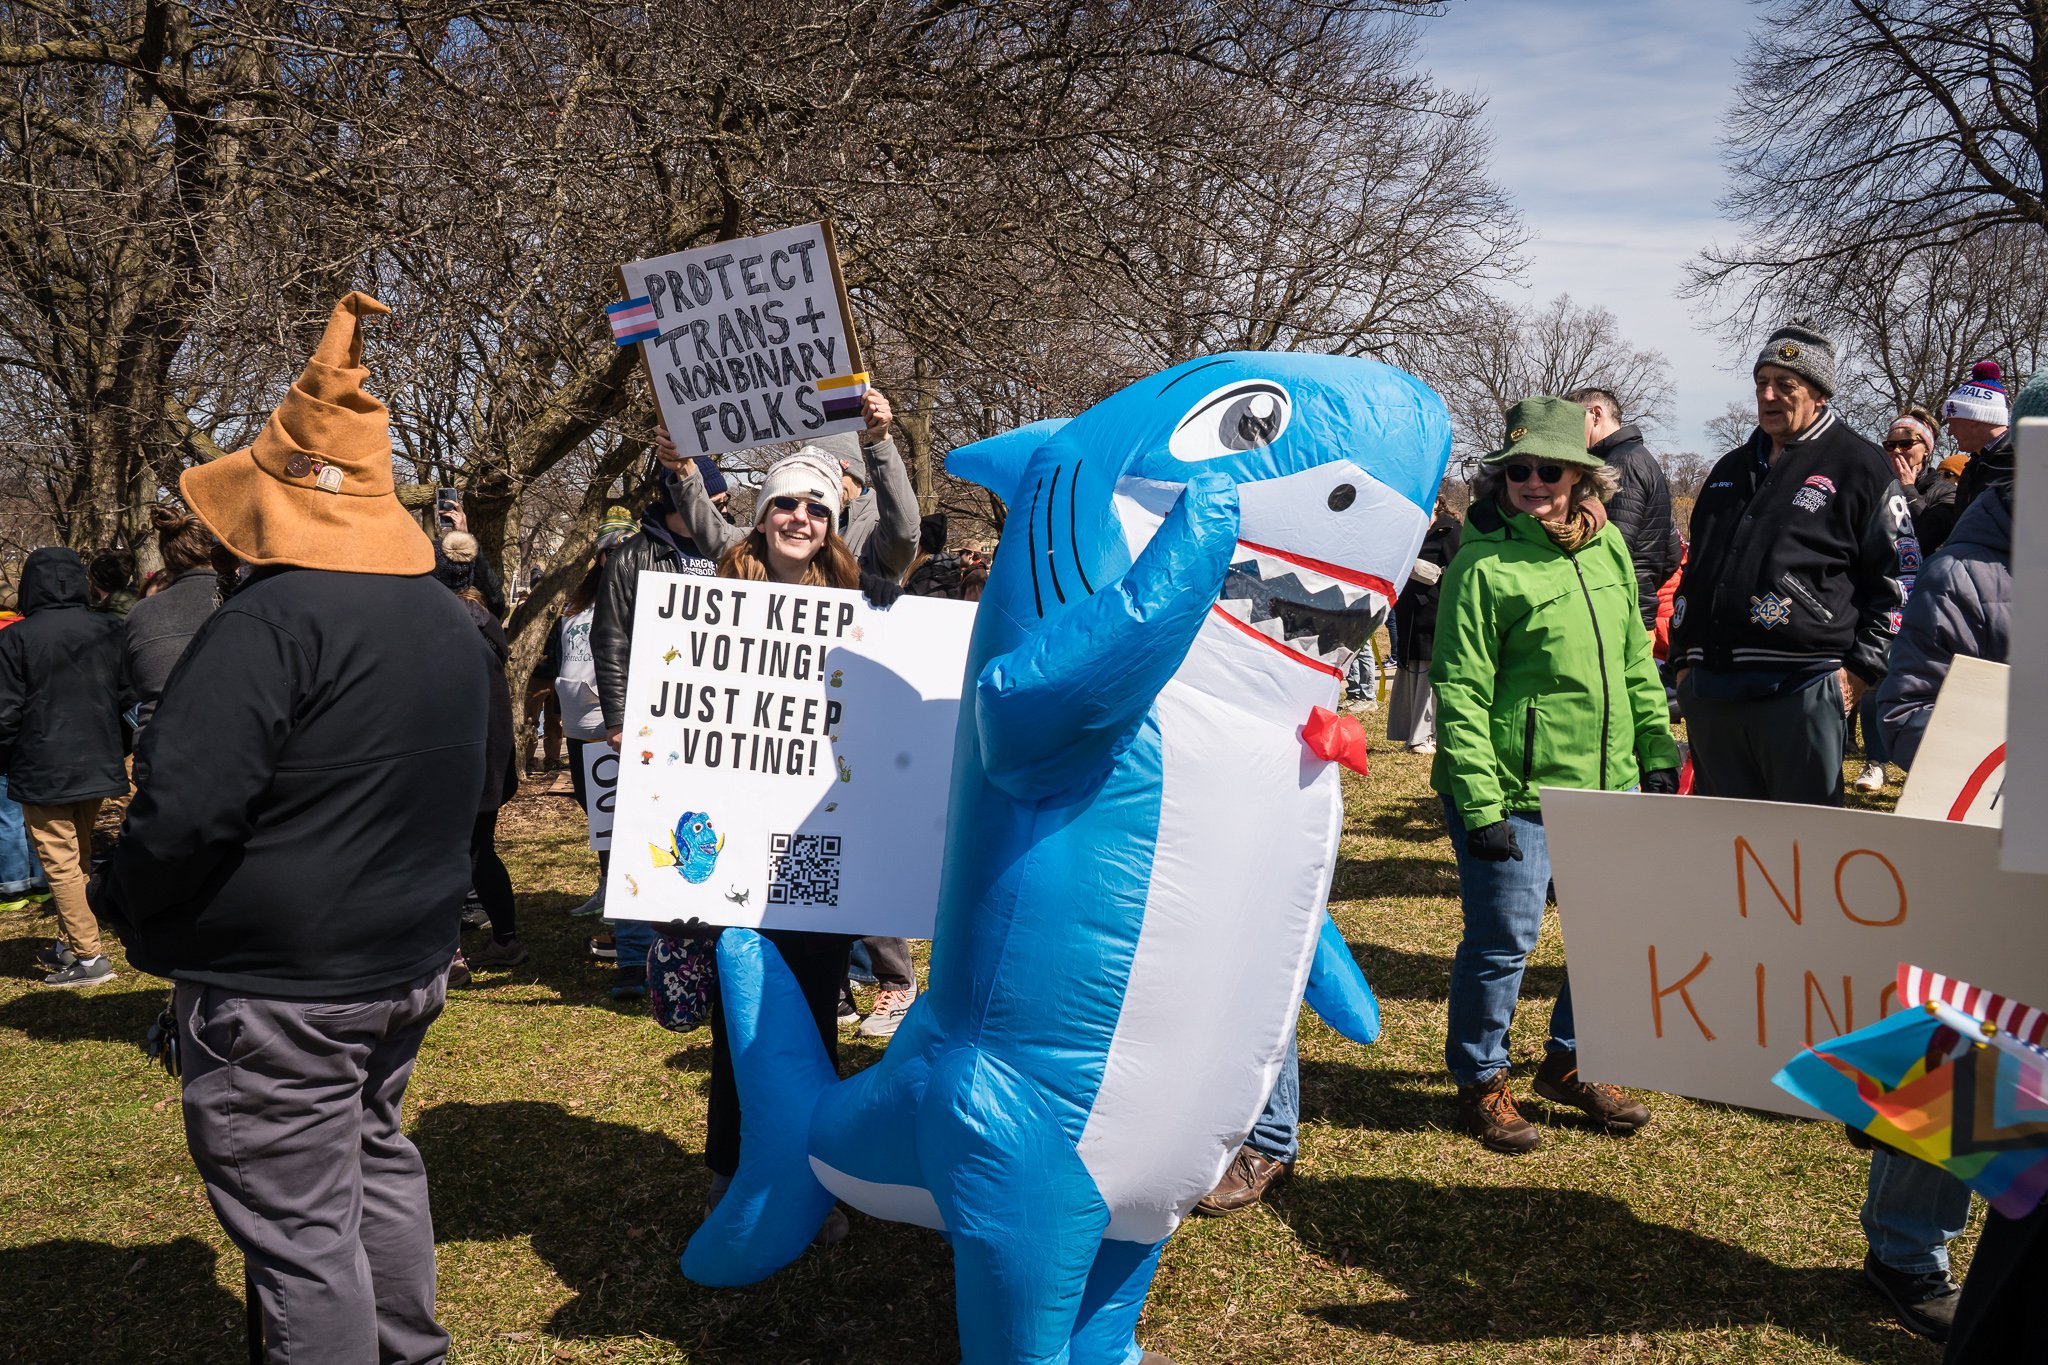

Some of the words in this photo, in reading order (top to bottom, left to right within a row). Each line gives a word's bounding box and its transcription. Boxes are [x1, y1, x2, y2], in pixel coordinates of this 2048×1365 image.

[644, 239, 816, 319] PROTECT
[666, 337, 836, 405] NONBINARY
[692, 385, 825, 452] FOLKS
[658, 583, 747, 627] JUST
[766, 594, 854, 638] KEEP
[1761, 604, 1777, 617] 42
[690, 631, 827, 682] VOTING!
[650, 681, 740, 724] JUST
[753, 691, 842, 736] KEEP
[683, 728, 818, 777] VOTING!
[1734, 835, 1907, 927] NO
